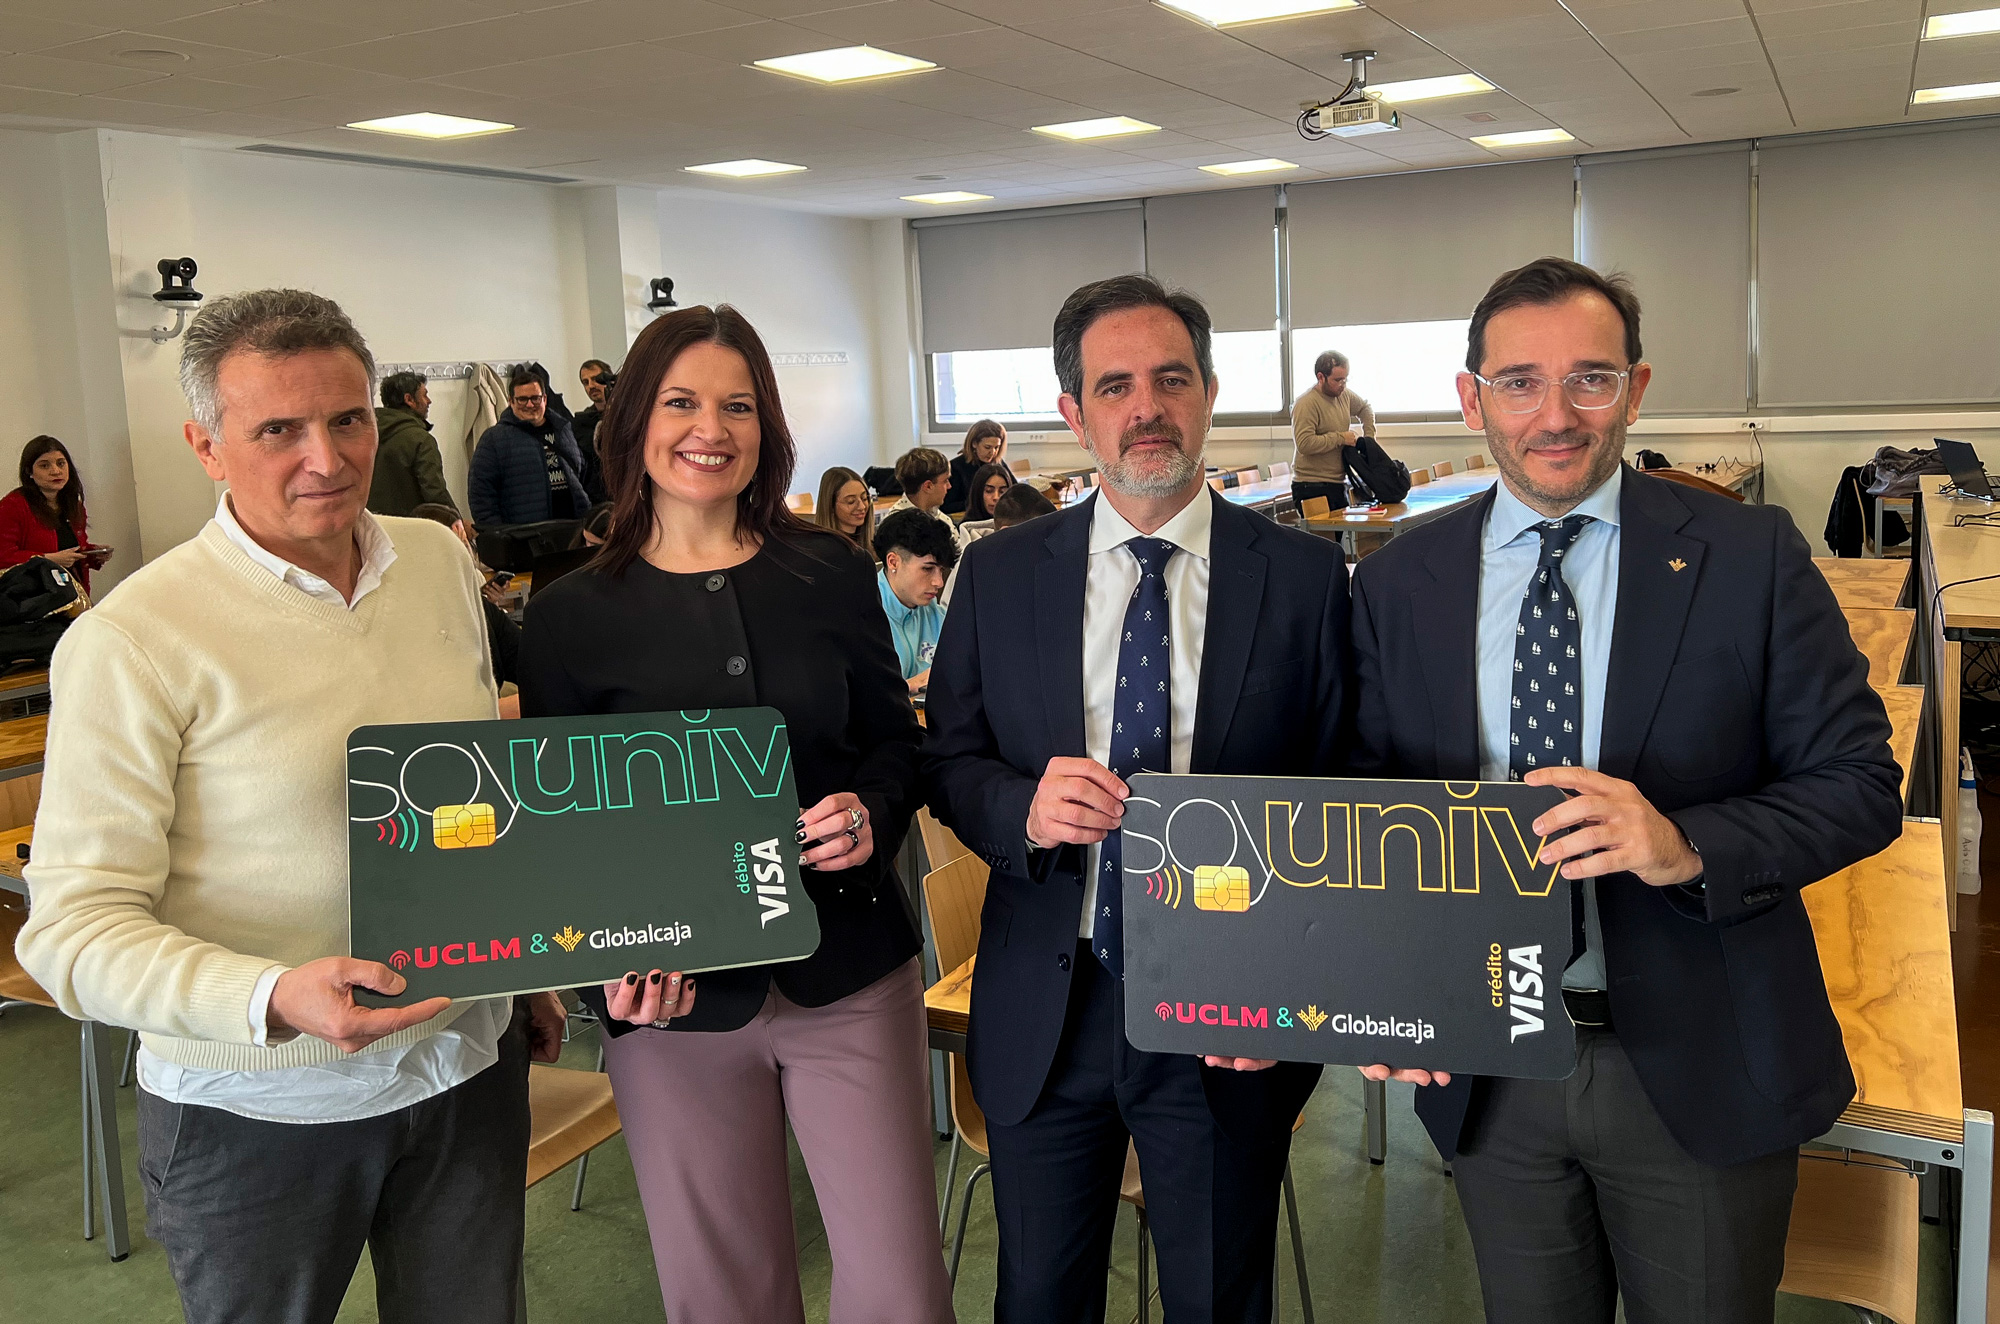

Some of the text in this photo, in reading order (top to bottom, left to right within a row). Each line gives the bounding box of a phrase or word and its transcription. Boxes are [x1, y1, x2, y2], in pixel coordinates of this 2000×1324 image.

[732, 841, 750, 894] débito
[750, 837, 791, 930] VISA
[413, 920, 693, 969] UCLM & Globalcaja
[1486, 942, 1504, 1008] crédito
[1507, 944, 1545, 1044] VISA
[1175, 1001, 1436, 1045] UCLM & Globalcaja
